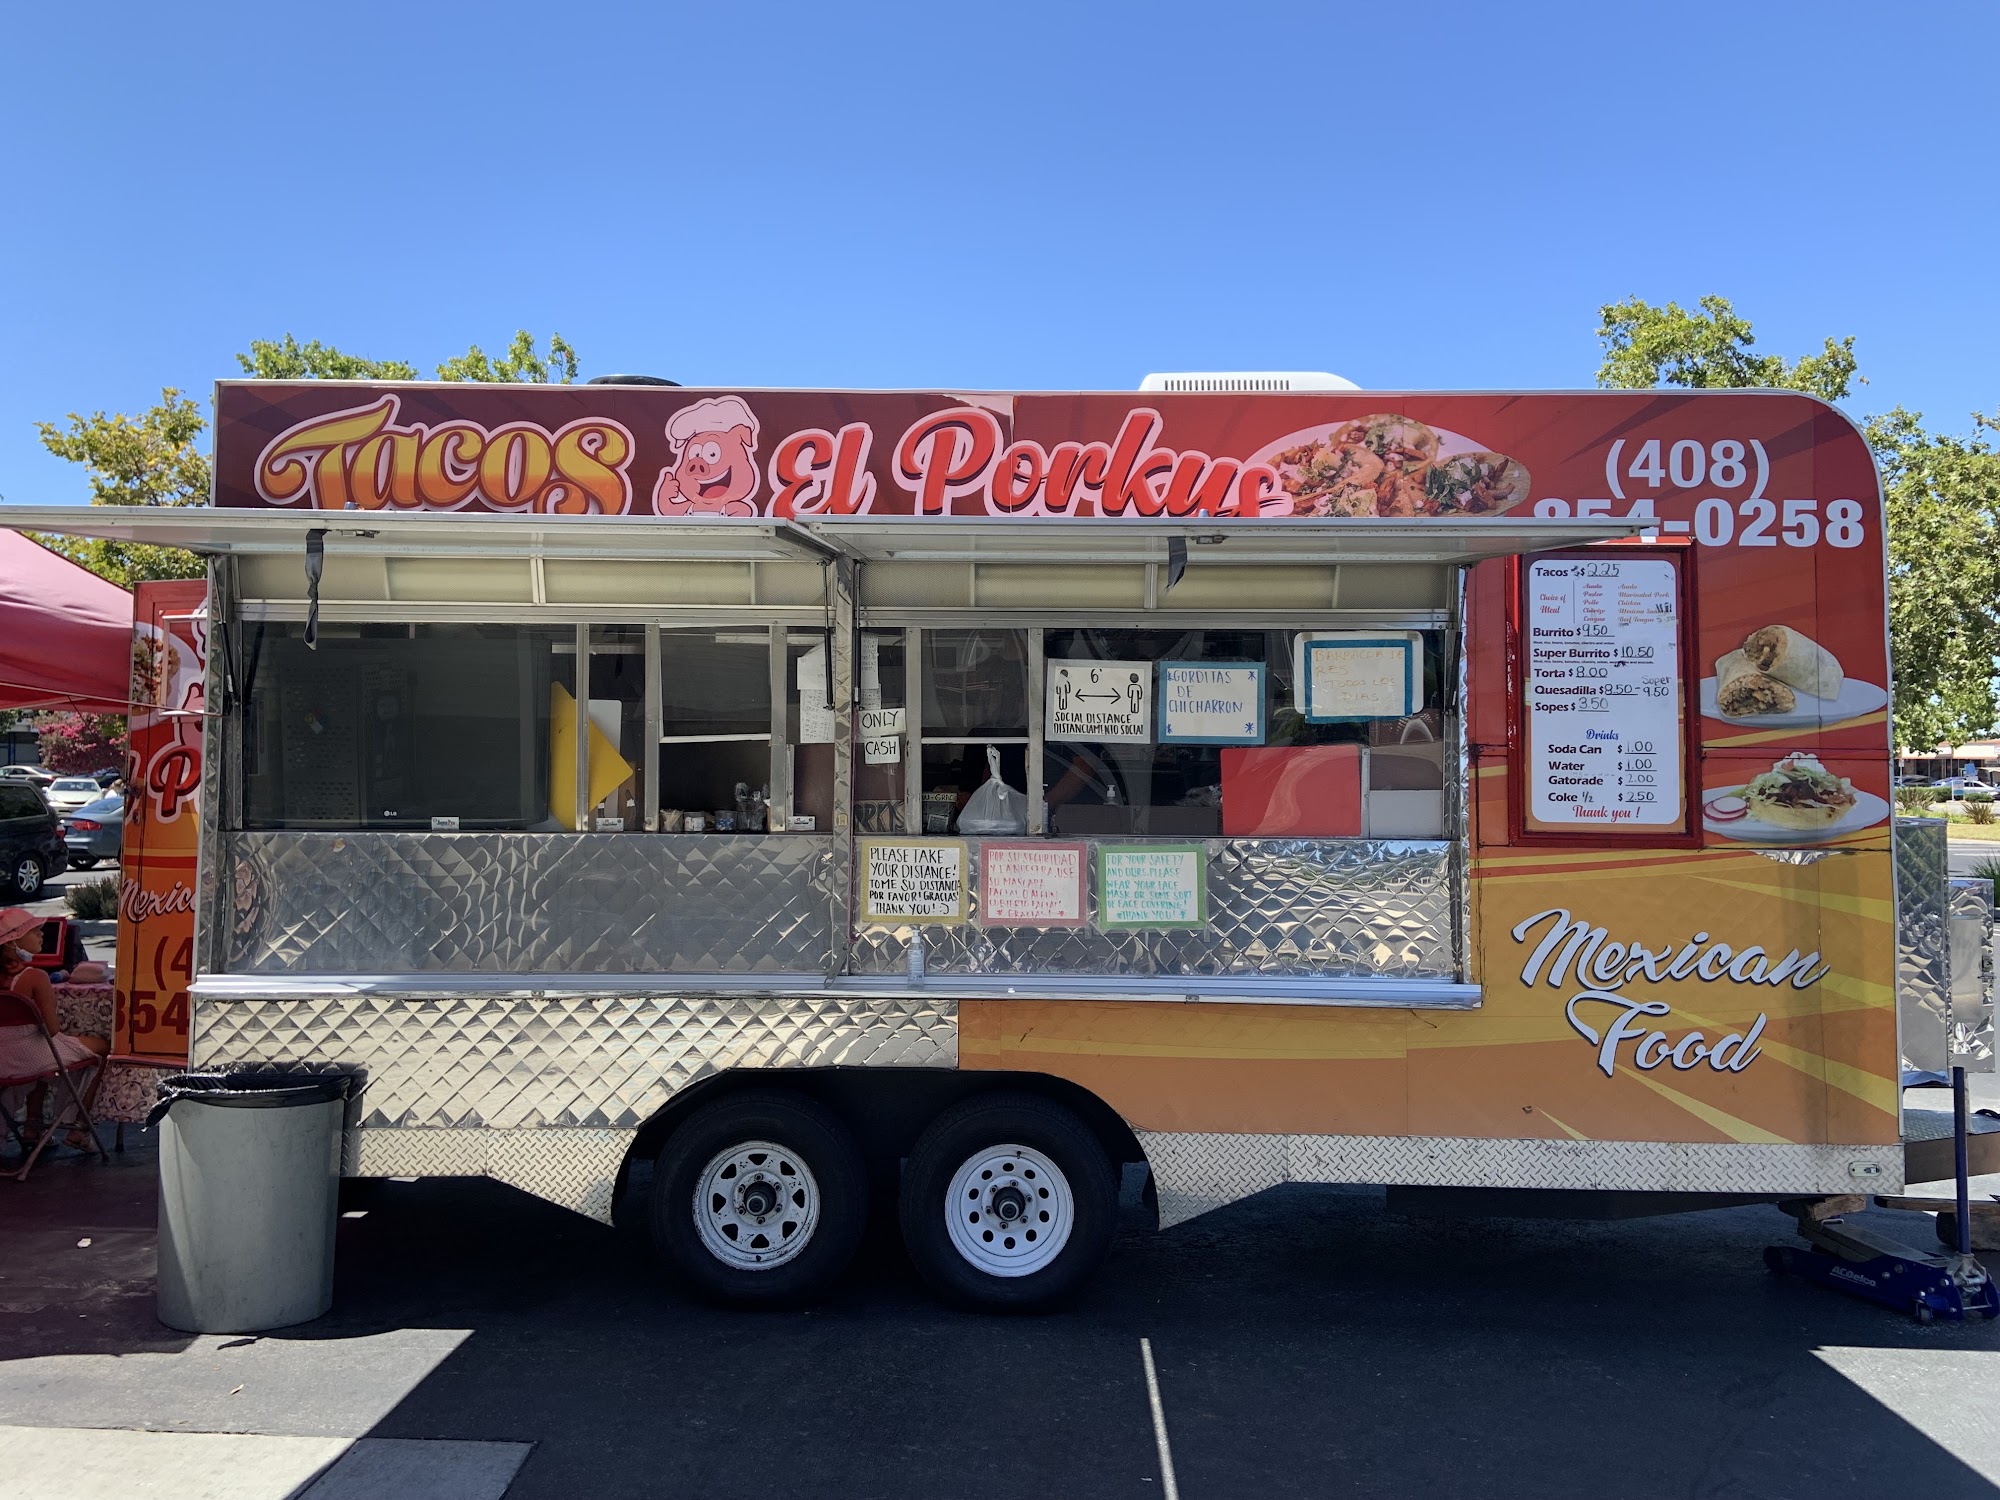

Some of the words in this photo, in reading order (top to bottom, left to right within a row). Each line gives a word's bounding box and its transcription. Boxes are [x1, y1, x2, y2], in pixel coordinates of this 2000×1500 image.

[256, 394, 632, 515] Tacos
[770, 424, 876, 517] El
[1605, 439, 1770, 499] (408)
[1535, 567, 1569, 577] Tacos
[1533, 627, 1573, 637] Burrito
[1533, 648, 1567, 660] Super
[1569, 648, 1611, 658] Burrito
[1174, 670, 1232, 684] GORDITAS
[1316, 666, 1349, 679] RES
[1535, 668, 1565, 678] Torta
[1177, 685, 1193, 698] DE
[1535, 685, 1596, 696] Quesadilla
[1343, 692, 1379, 702] DIAS
[1168, 700, 1243, 714] CHICHARRON
[1535, 702, 1568, 713] Sopes
[862, 710, 899, 729] ONLY
[1055, 712, 1083, 724] SOCIAL
[1086, 712, 1132, 724] DISTANCE
[1053, 722, 1119, 735] DISTANCIAMENTO
[1586, 729, 1619, 740] Drinks
[865, 741, 897, 755] CASH
[1548, 745, 1577, 754] Soda
[1579, 745, 1602, 754] Can
[1548, 761, 1585, 771] Water
[1548, 776, 1603, 785] Gatorade
[1548, 792, 1577, 802] Coke
[1572, 805, 1608, 818] Thank
[870, 848, 908, 862] PLEASE
[913, 849, 945, 864] TAKE
[989, 851, 1004, 862] POR
[1008, 852, 1020, 862] SU
[1023, 852, 1077, 866] SEGURIDAD
[1107, 854, 1122, 866] FOR
[1126, 854, 1146, 865] YOUR
[1150, 854, 1184, 866] SAFETY
[870, 862, 898, 878] YOUR
[902, 864, 956, 879] DISTANCE!
[1107, 868, 1124, 878] AND
[869, 879, 897, 890] TOME
[901, 880, 916, 892] SU
[920, 880, 964, 892] DISTANCIA
[1106, 880, 1130, 890] WEAR
[1134, 880, 1156, 890] YOUR
[1158, 880, 1180, 890] FACE
[870, 890, 884, 900] POR
[1106, 890, 1130, 900] MASK
[1134, 890, 1145, 900] OR
[1149, 890, 1170, 900] SOME
[1173, 890, 1192, 900] SORT
[874, 903, 906, 914] THANK
[910, 903, 936, 915] YOU!
[1118, 900, 1138, 909] FACE
[1512, 908, 1830, 990] Mexican
[1565, 990, 1768, 1077] Food
